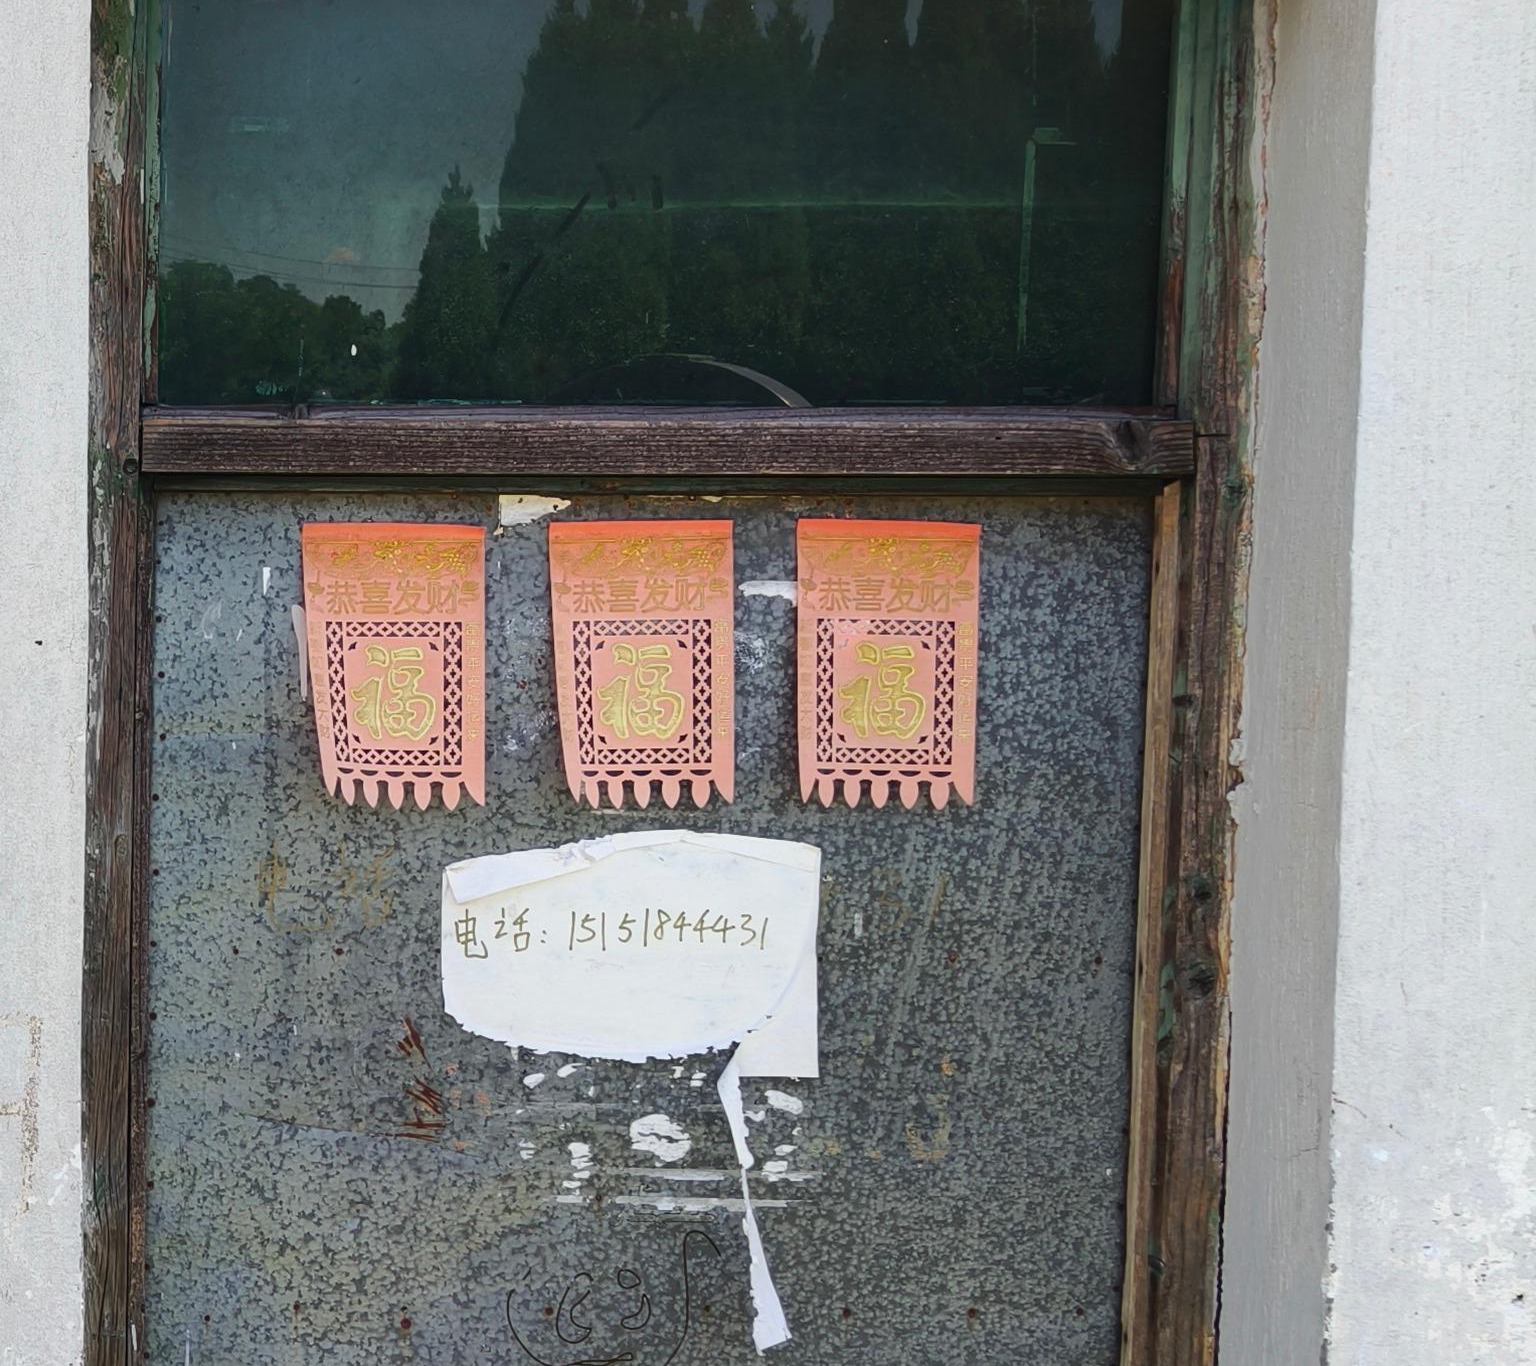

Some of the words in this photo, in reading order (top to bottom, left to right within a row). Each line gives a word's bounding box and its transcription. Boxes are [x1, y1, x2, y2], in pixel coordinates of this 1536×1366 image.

[326, 579, 458, 615] 恭喜发财
[573, 577, 708, 614] 恭喜发财
[818, 576, 953, 614] 恭喜发财
[351, 643, 437, 741] 福
[597, 642, 685, 740] 福
[838, 641, 926, 740] 福
